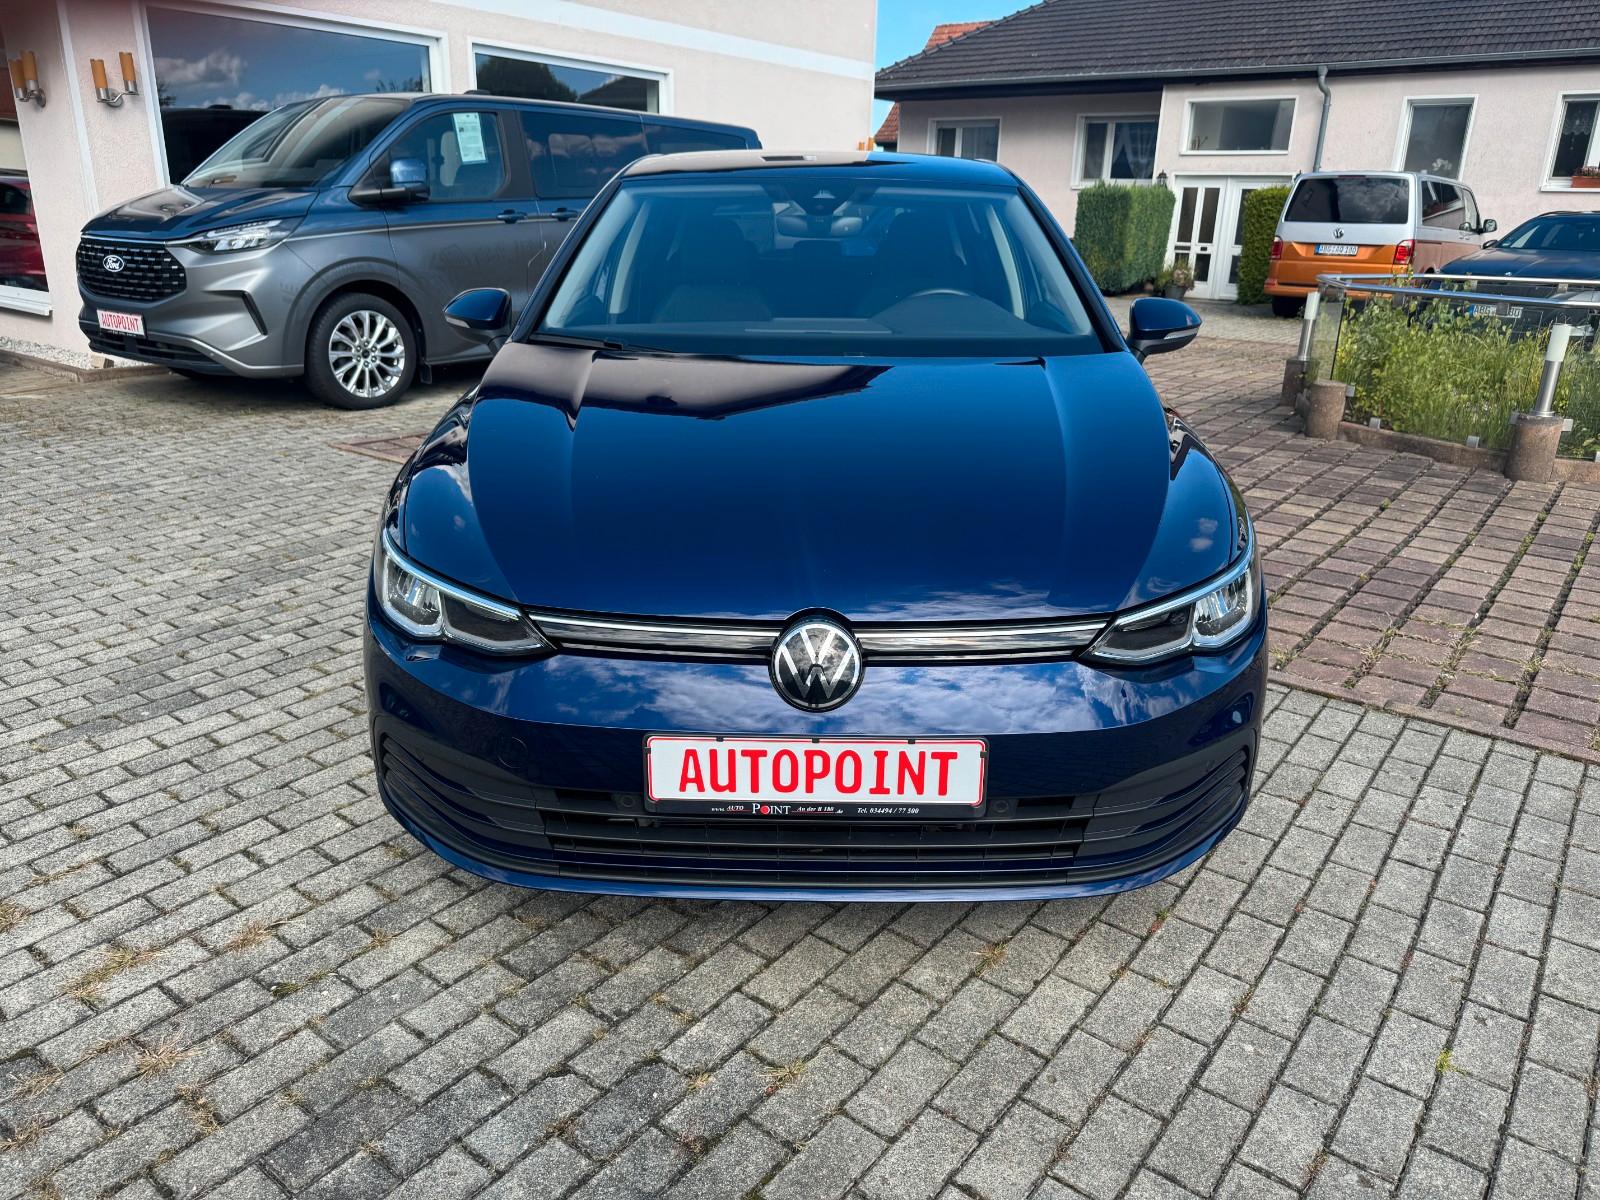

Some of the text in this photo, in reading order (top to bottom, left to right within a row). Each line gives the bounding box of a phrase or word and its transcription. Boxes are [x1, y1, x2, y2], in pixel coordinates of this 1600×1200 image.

[105, 257, 121, 270] Ford
[101, 313, 140, 332] AUTOPOINT
[775, 622, 860, 708] VW
[678, 748, 958, 796] AUTOPOINT
[752, 802, 791, 815] POINT
